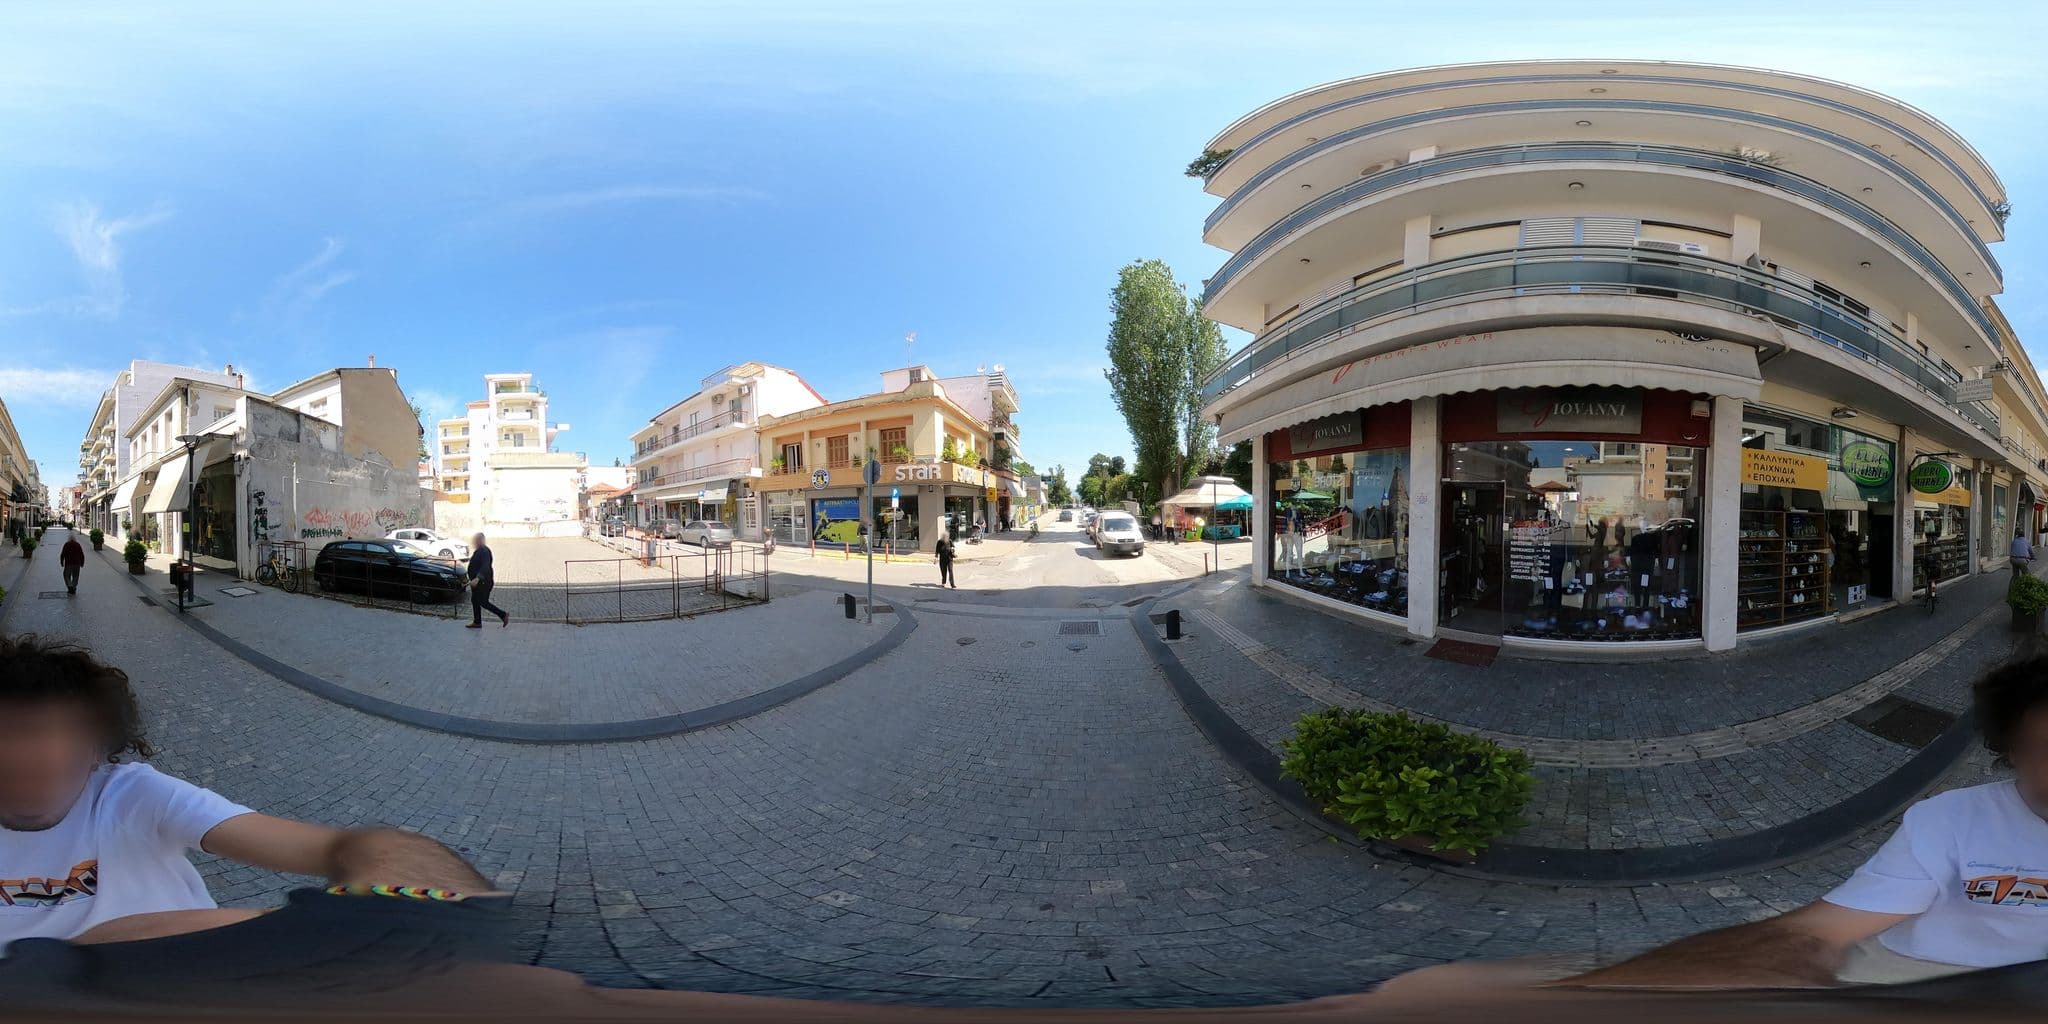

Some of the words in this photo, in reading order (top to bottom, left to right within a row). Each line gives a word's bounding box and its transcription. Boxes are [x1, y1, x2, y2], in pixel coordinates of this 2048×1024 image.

[1753, 452, 1805, 468] ΚΑΛΛΥΝΤΙΚΑ
[1753, 463, 1795, 475] ΠΑΙΧΝΙΔΙΑ
[1753, 473, 1796, 485] ΕΠΟΧΙΑΚΑ
